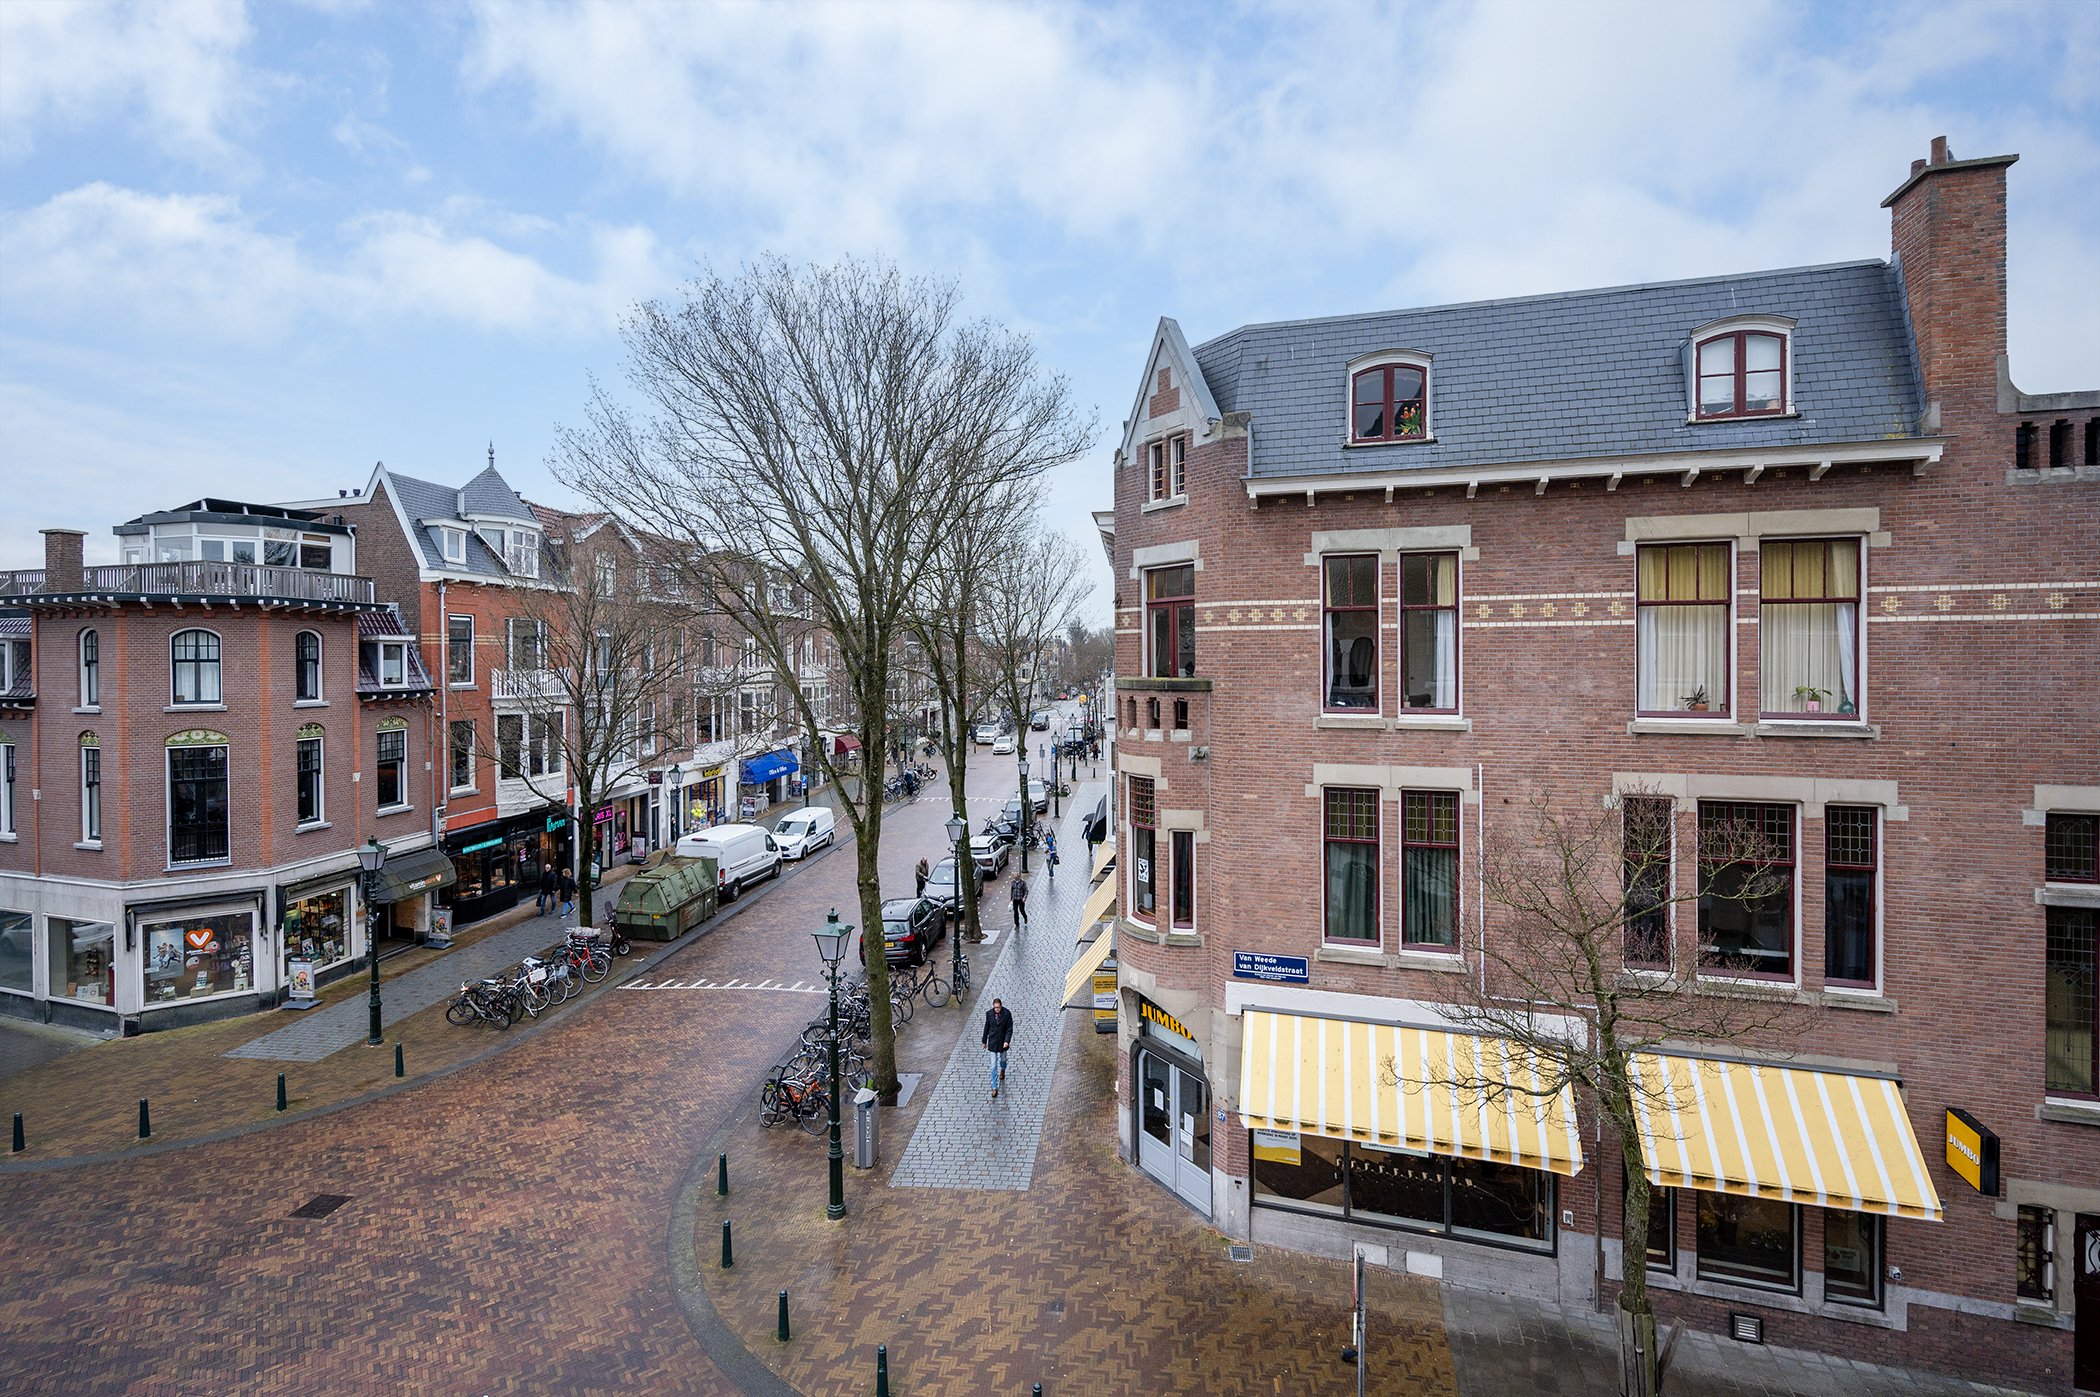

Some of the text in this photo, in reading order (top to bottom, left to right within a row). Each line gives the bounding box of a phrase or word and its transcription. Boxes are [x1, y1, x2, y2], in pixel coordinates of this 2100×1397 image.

[1238, 954, 1277, 964] Van Weede
[1254, 963, 1304, 975] Dijkveldstraat
[1141, 1002, 1193, 1040] JUMBO
[1948, 1133, 1980, 1167] JUMBO
